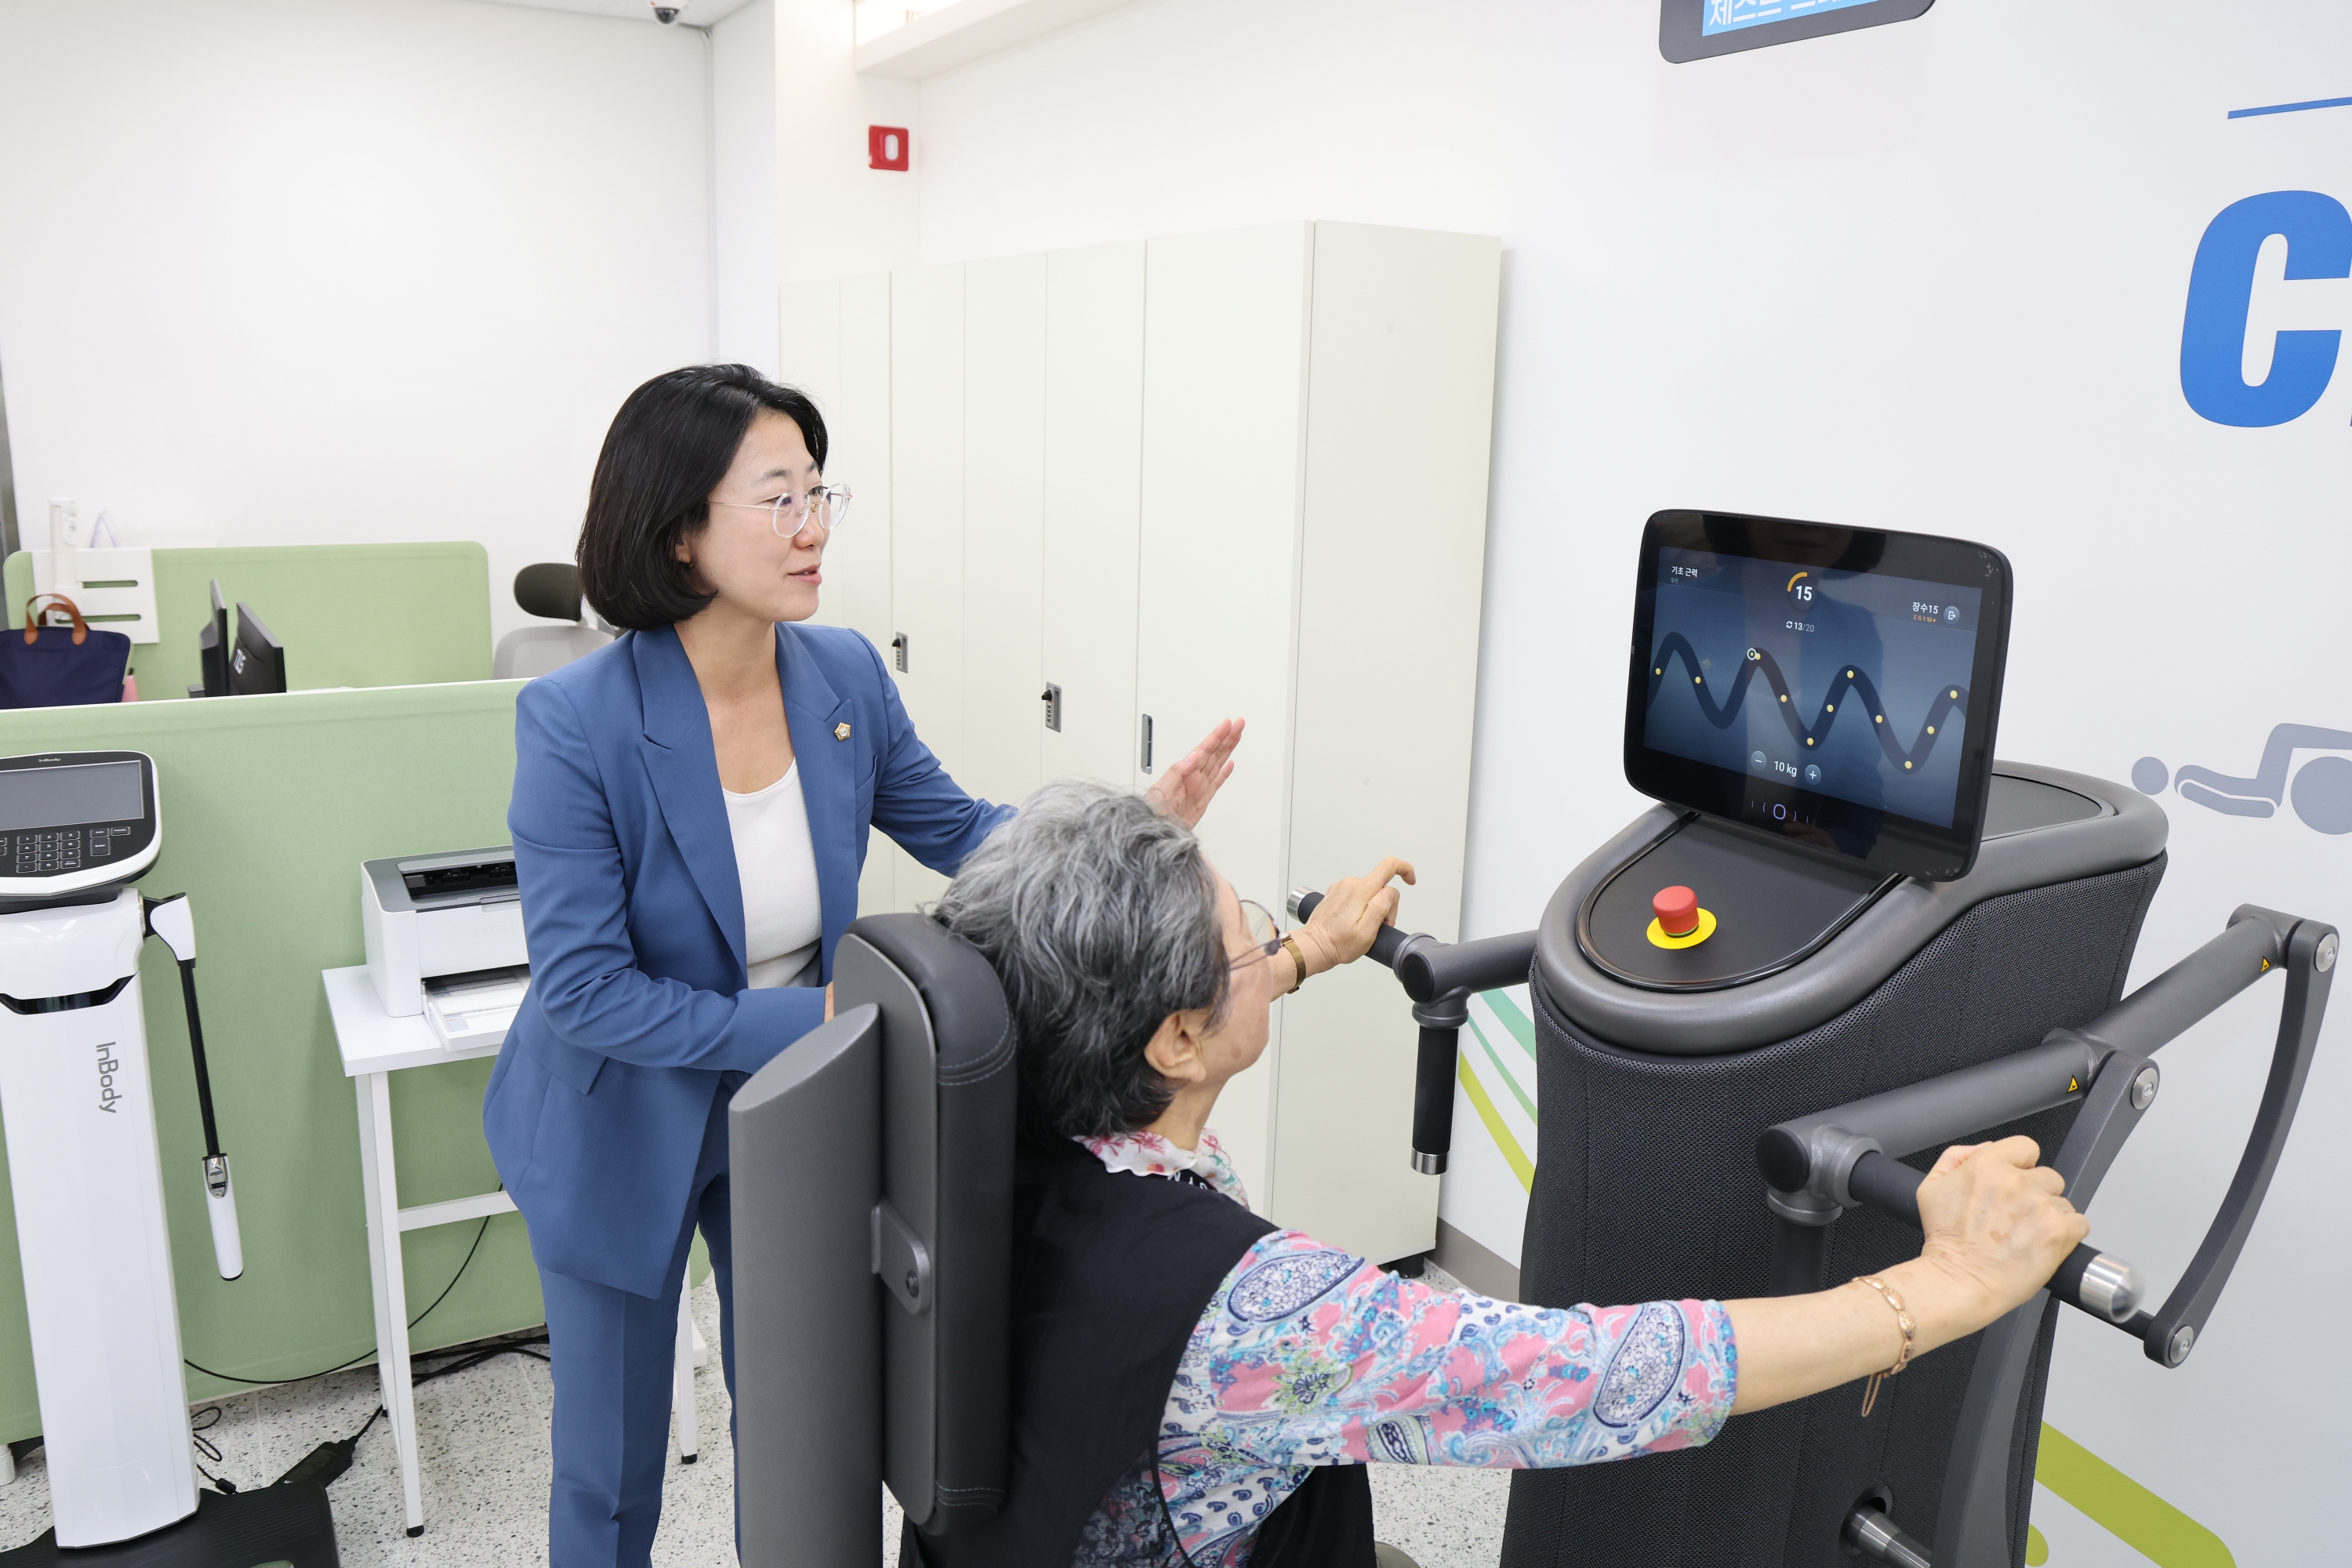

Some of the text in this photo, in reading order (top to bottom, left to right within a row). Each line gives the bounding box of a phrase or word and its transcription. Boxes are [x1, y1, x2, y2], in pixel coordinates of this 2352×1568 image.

[2180, 190, 2352, 428] C
[1671, 565, 1698, 578] 기초 근력
[1795, 585, 1813, 601] 15
[1912, 601, 1939, 615] 장수15
[1794, 622, 1815, 633] 13/20
[1774, 760, 1798, 778] 10 kg
[96, 1041, 122, 1114] InBody
